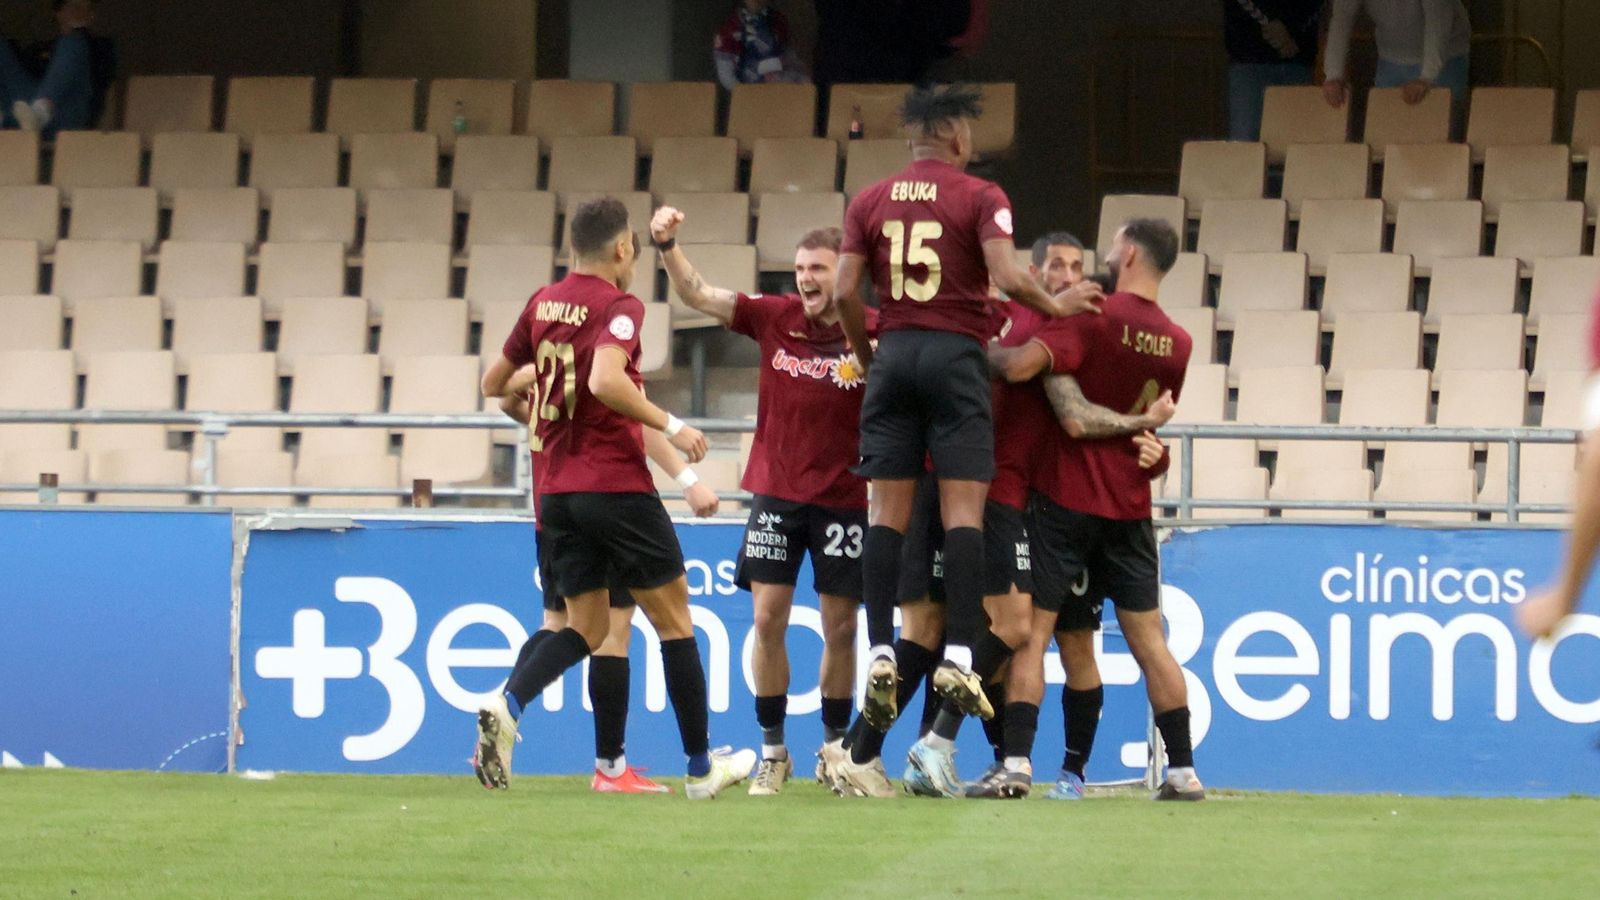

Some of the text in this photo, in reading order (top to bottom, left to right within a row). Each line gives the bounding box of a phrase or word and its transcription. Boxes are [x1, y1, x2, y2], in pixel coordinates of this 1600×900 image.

[890, 181, 937, 202] EBUKA
[882, 220, 943, 302] 15
[536, 301, 588, 327] MORILLAS
[1135, 331, 1173, 357] SOLER
[537, 339, 576, 421] 21
[747, 529, 788, 548] MODERA
[824, 523, 864, 559] 23
[746, 543, 787, 561] EMPLEO
[1321, 553, 1526, 604] clínicas
